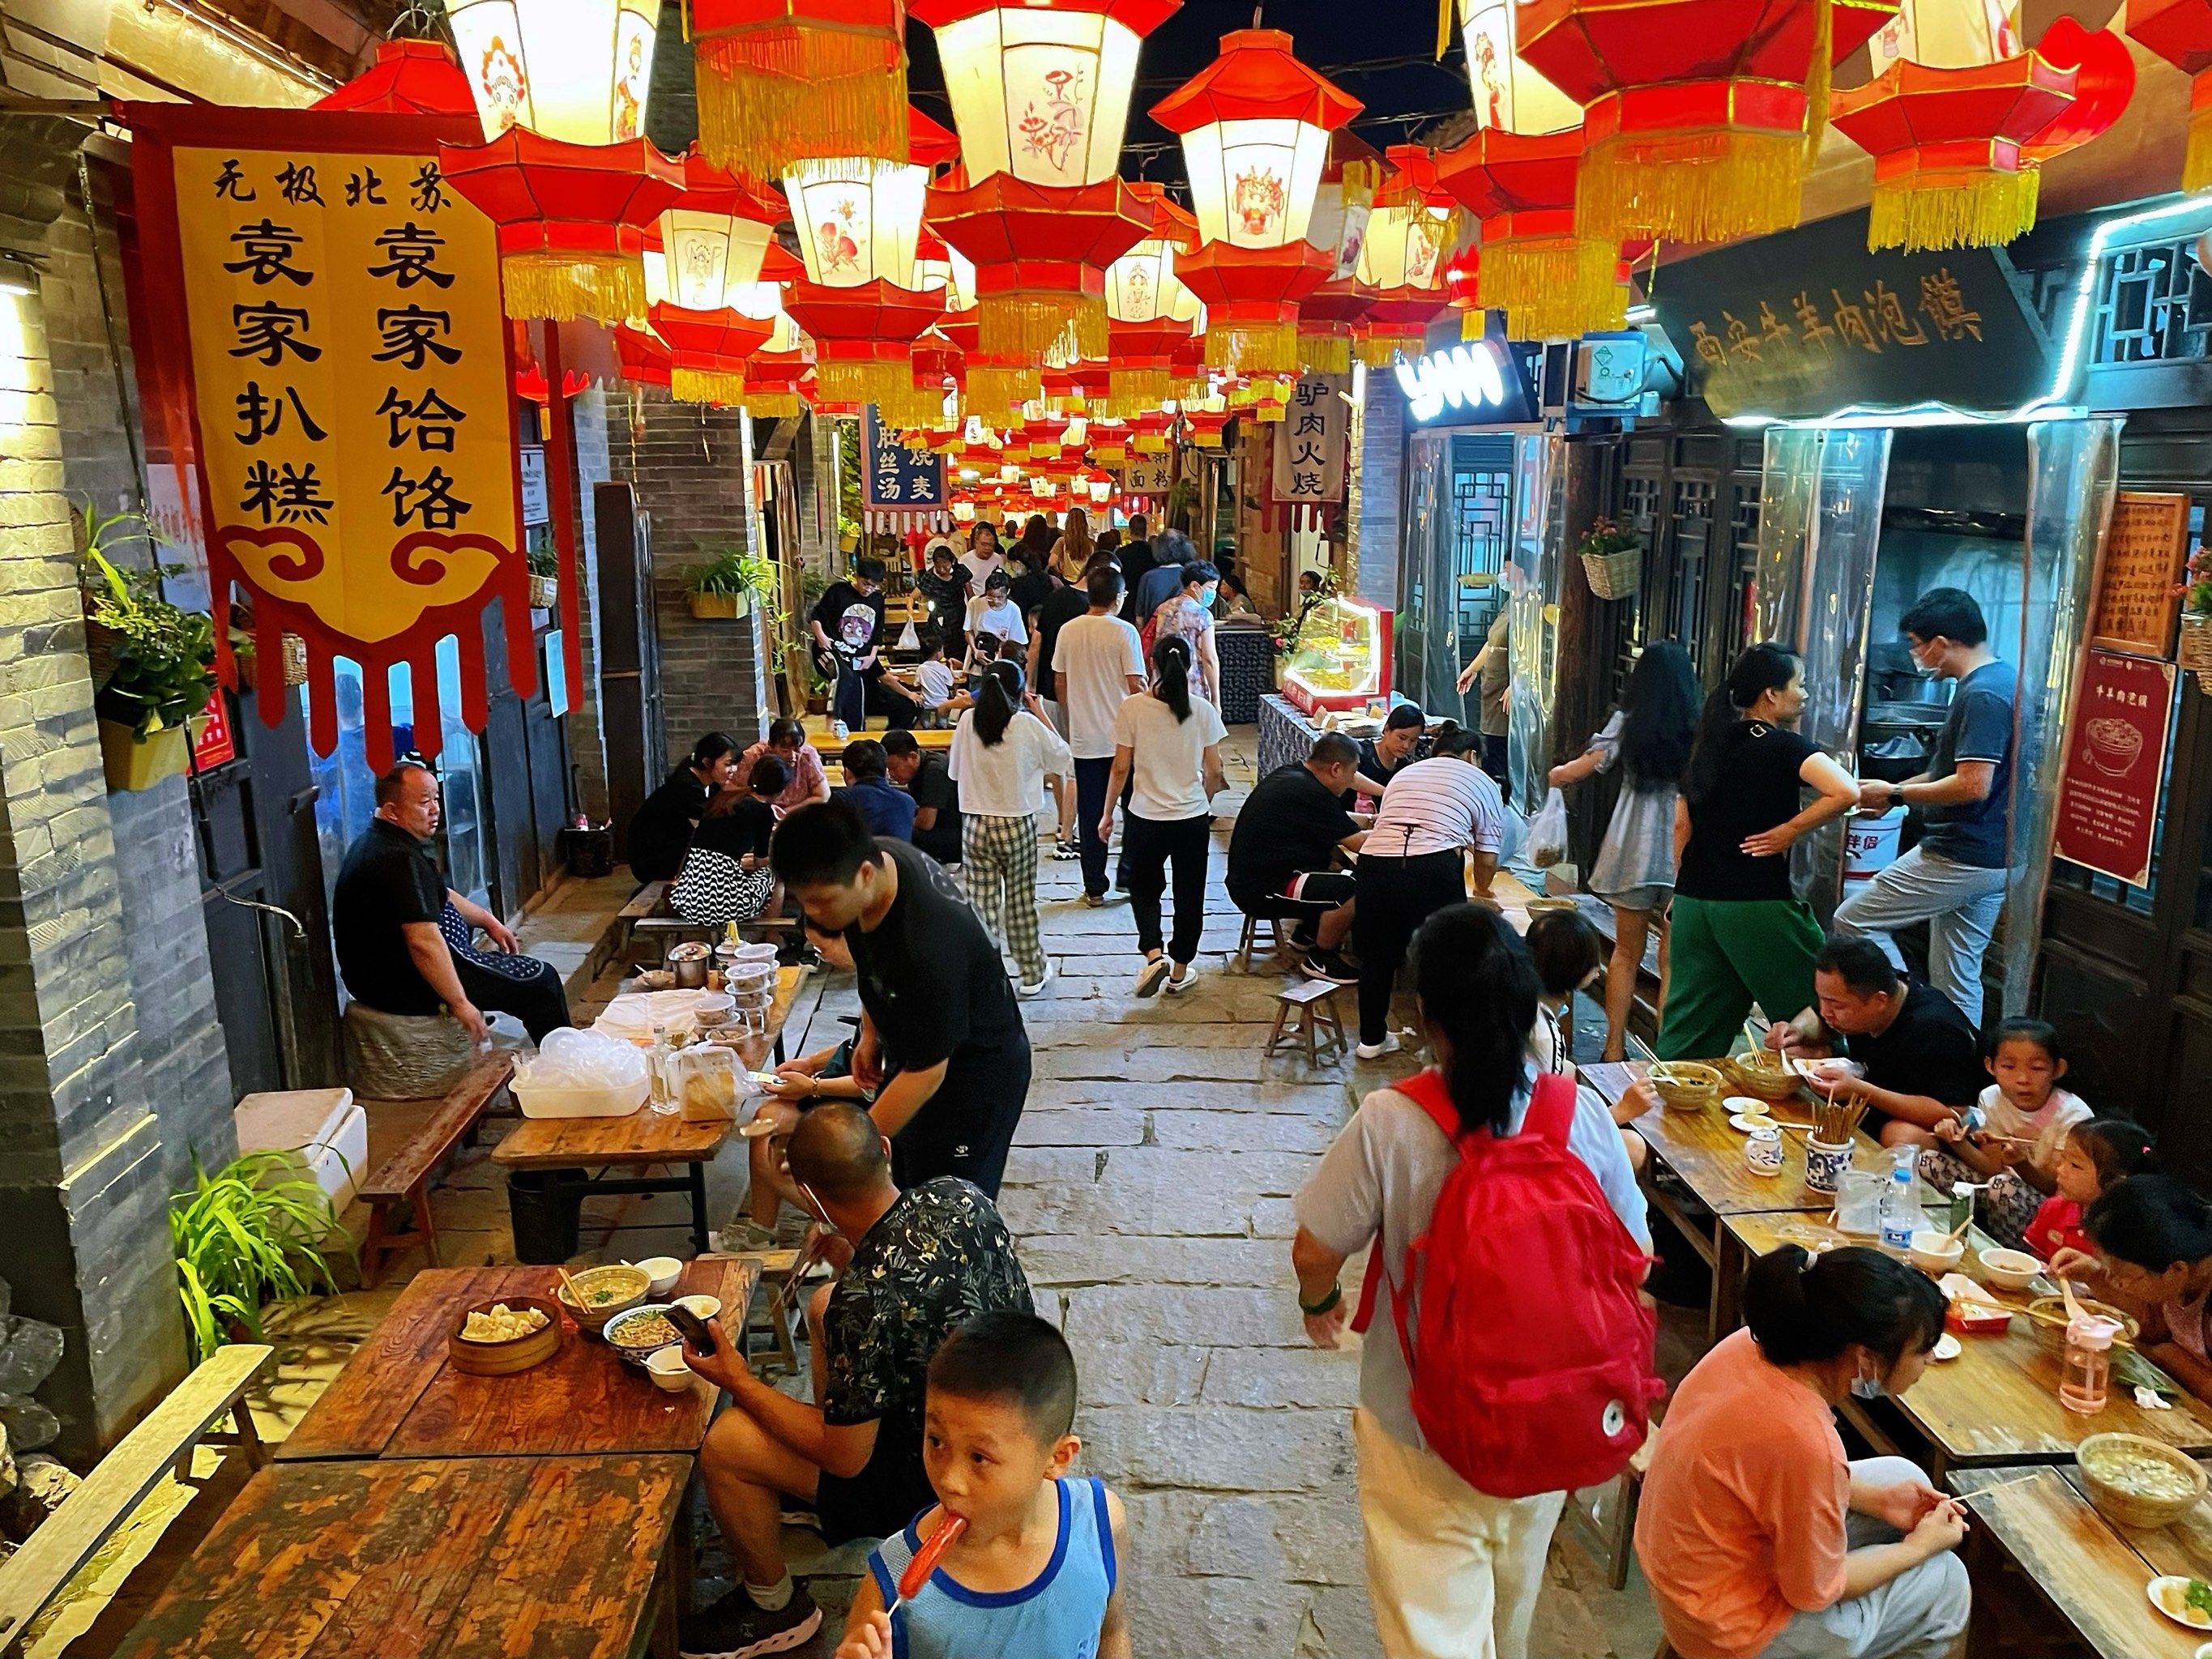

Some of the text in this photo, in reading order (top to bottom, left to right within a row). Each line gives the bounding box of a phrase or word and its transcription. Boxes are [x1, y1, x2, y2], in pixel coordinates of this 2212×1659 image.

[213, 159, 453, 214] 无极北苏
[222, 218, 335, 526] 袁家扒糕
[367, 221, 473, 531] 袁家饸饹
[874, 404, 901, 500] 肚丝汤
[908, 446, 934, 500] 烧麦
[1290, 382, 1330, 495] 驴肉火烧
